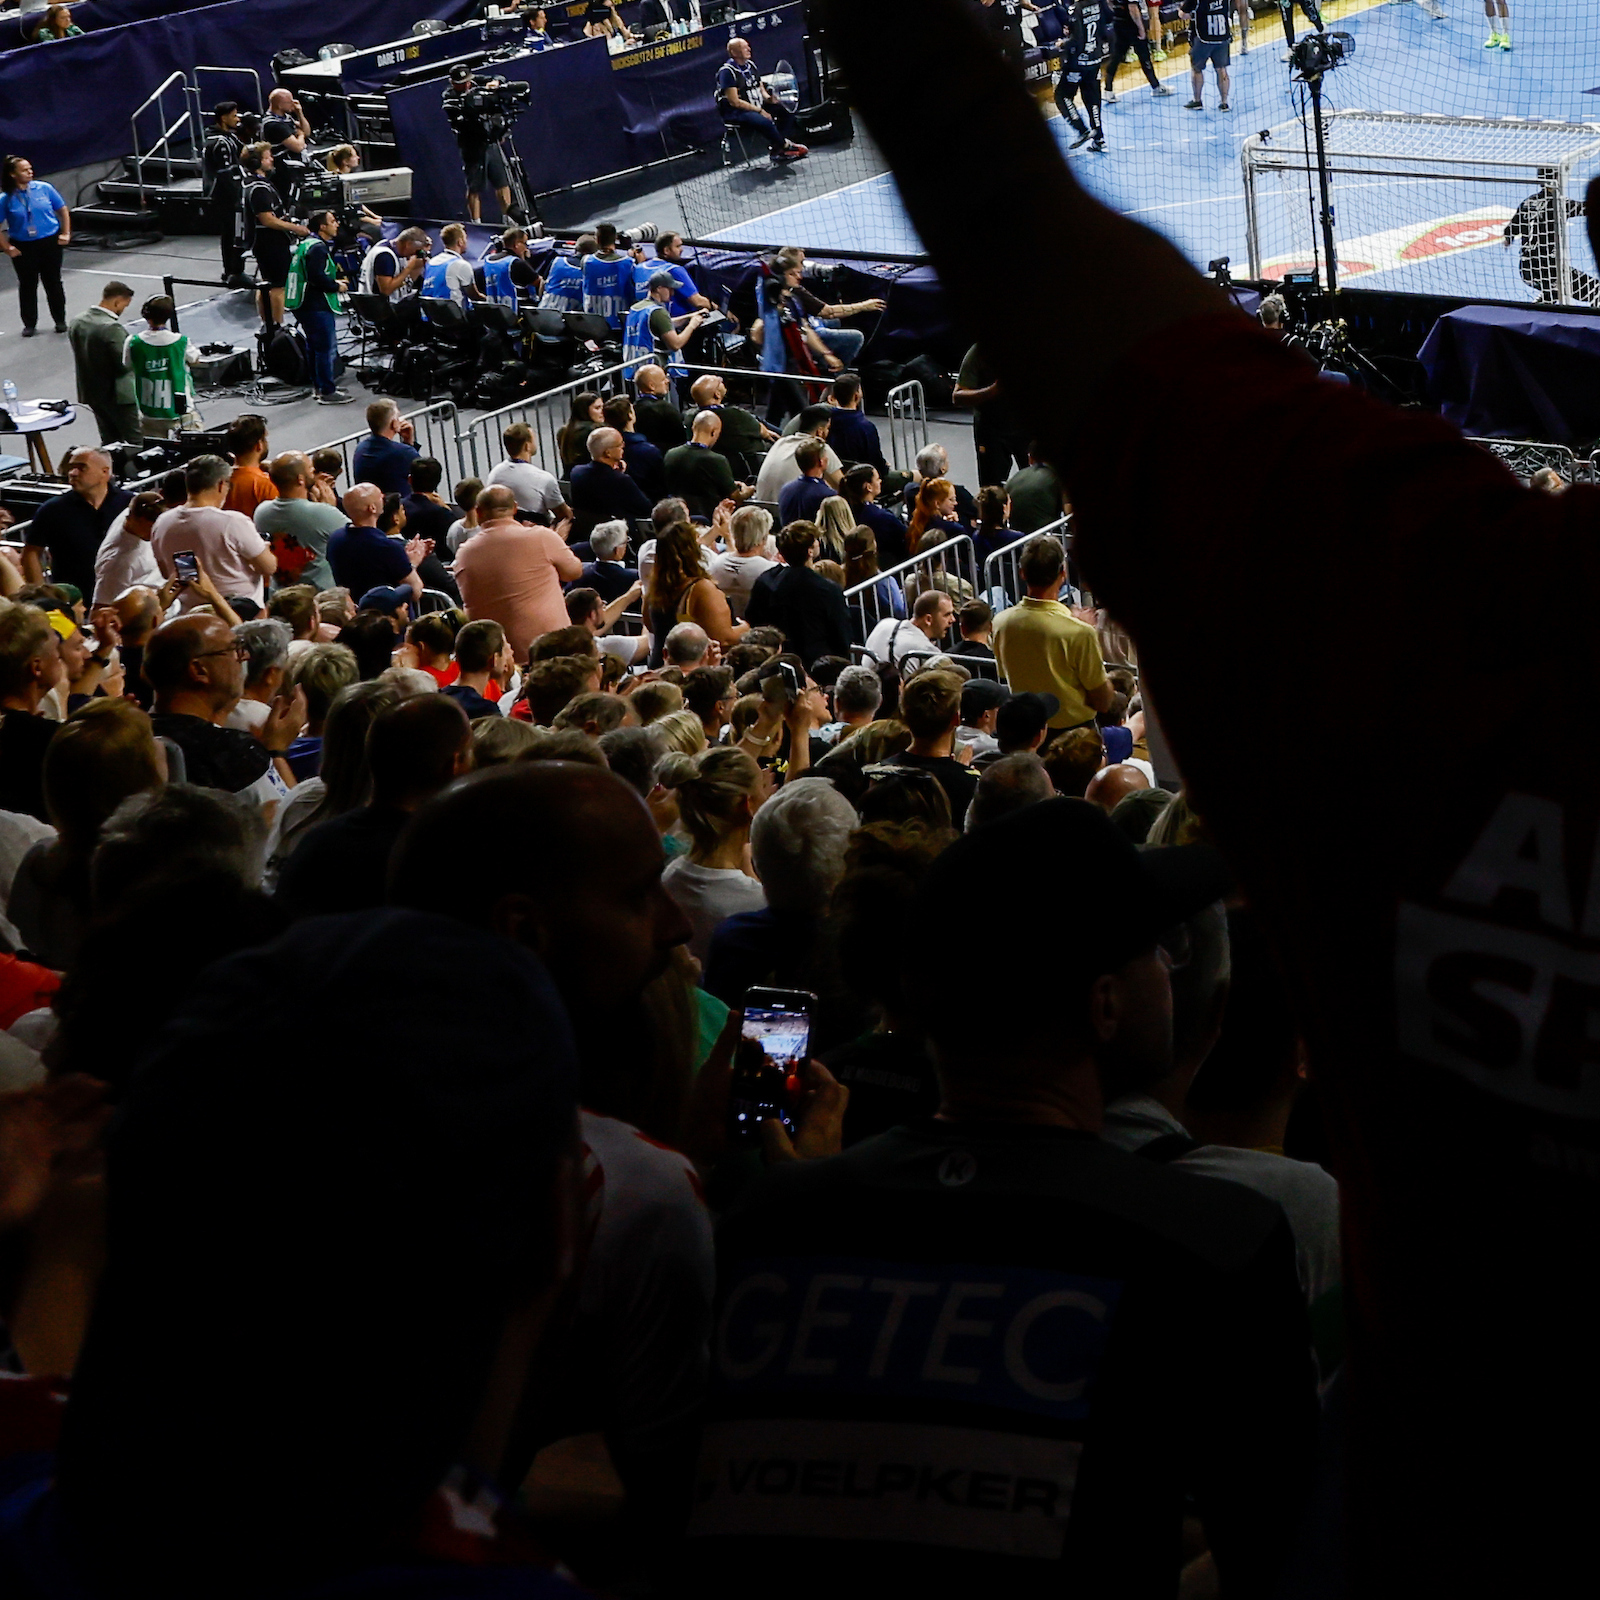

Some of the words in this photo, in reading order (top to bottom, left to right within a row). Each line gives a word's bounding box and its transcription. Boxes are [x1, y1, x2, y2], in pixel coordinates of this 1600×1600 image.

[1206, 13, 1227, 37] HB
[713, 1271, 1107, 1401] GETEC
[726, 1458, 1061, 1518] VOELPKER
